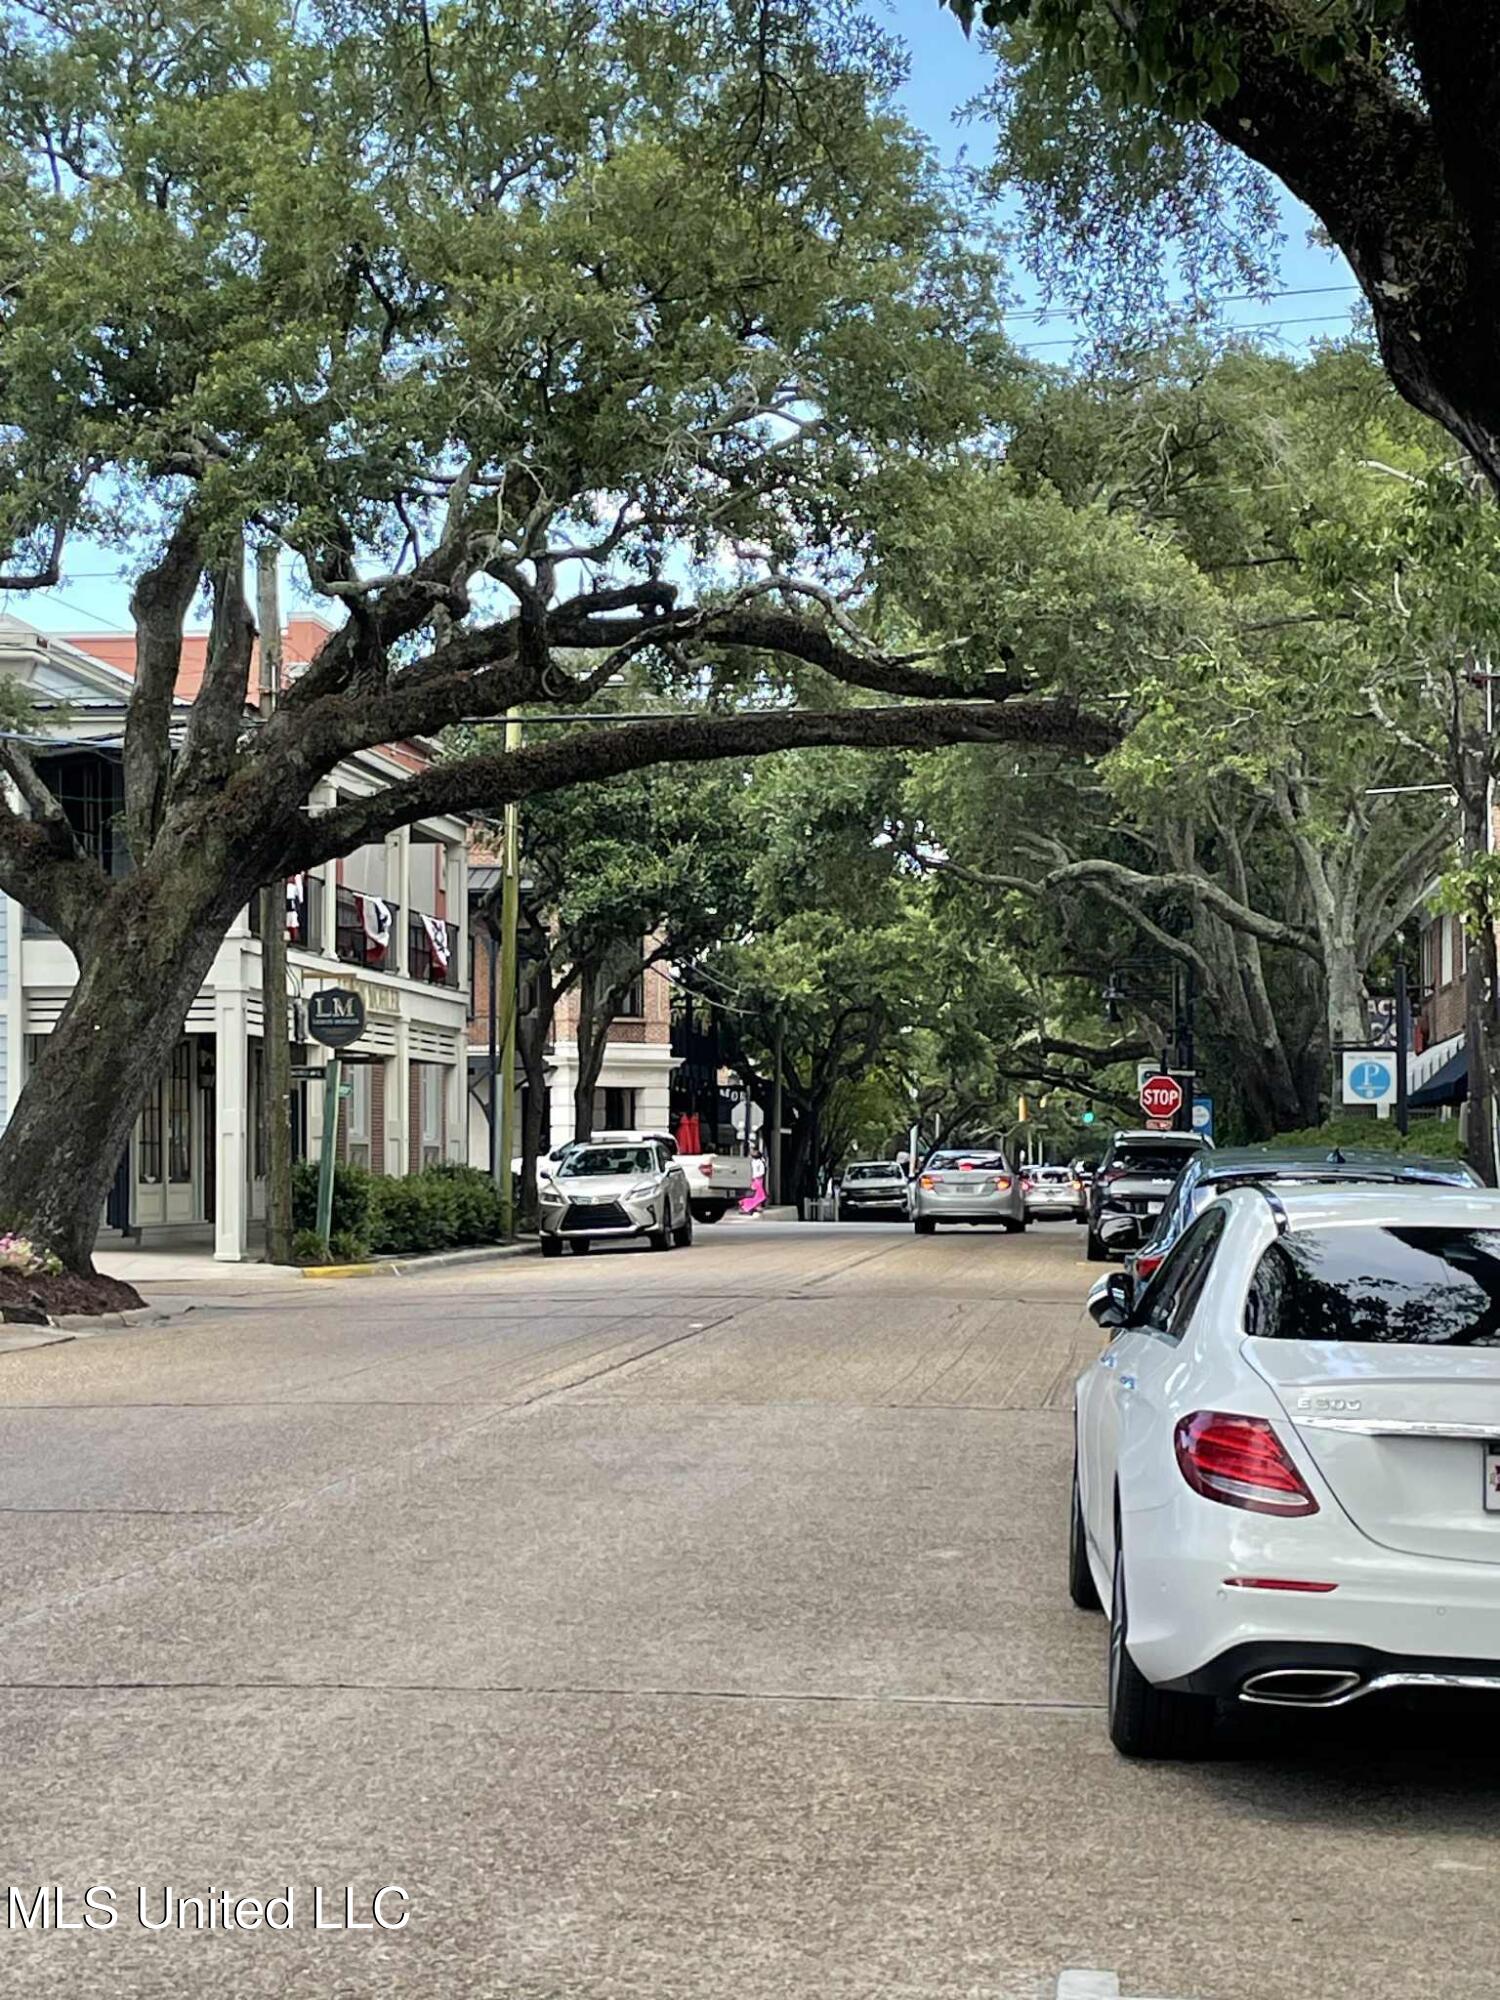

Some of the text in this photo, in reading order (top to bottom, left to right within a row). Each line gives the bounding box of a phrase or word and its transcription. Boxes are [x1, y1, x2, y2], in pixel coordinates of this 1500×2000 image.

[315, 997, 355, 1018] LM
[1363, 1065, 1380, 1086] P
[1143, 1089, 1179, 1106] STOP
